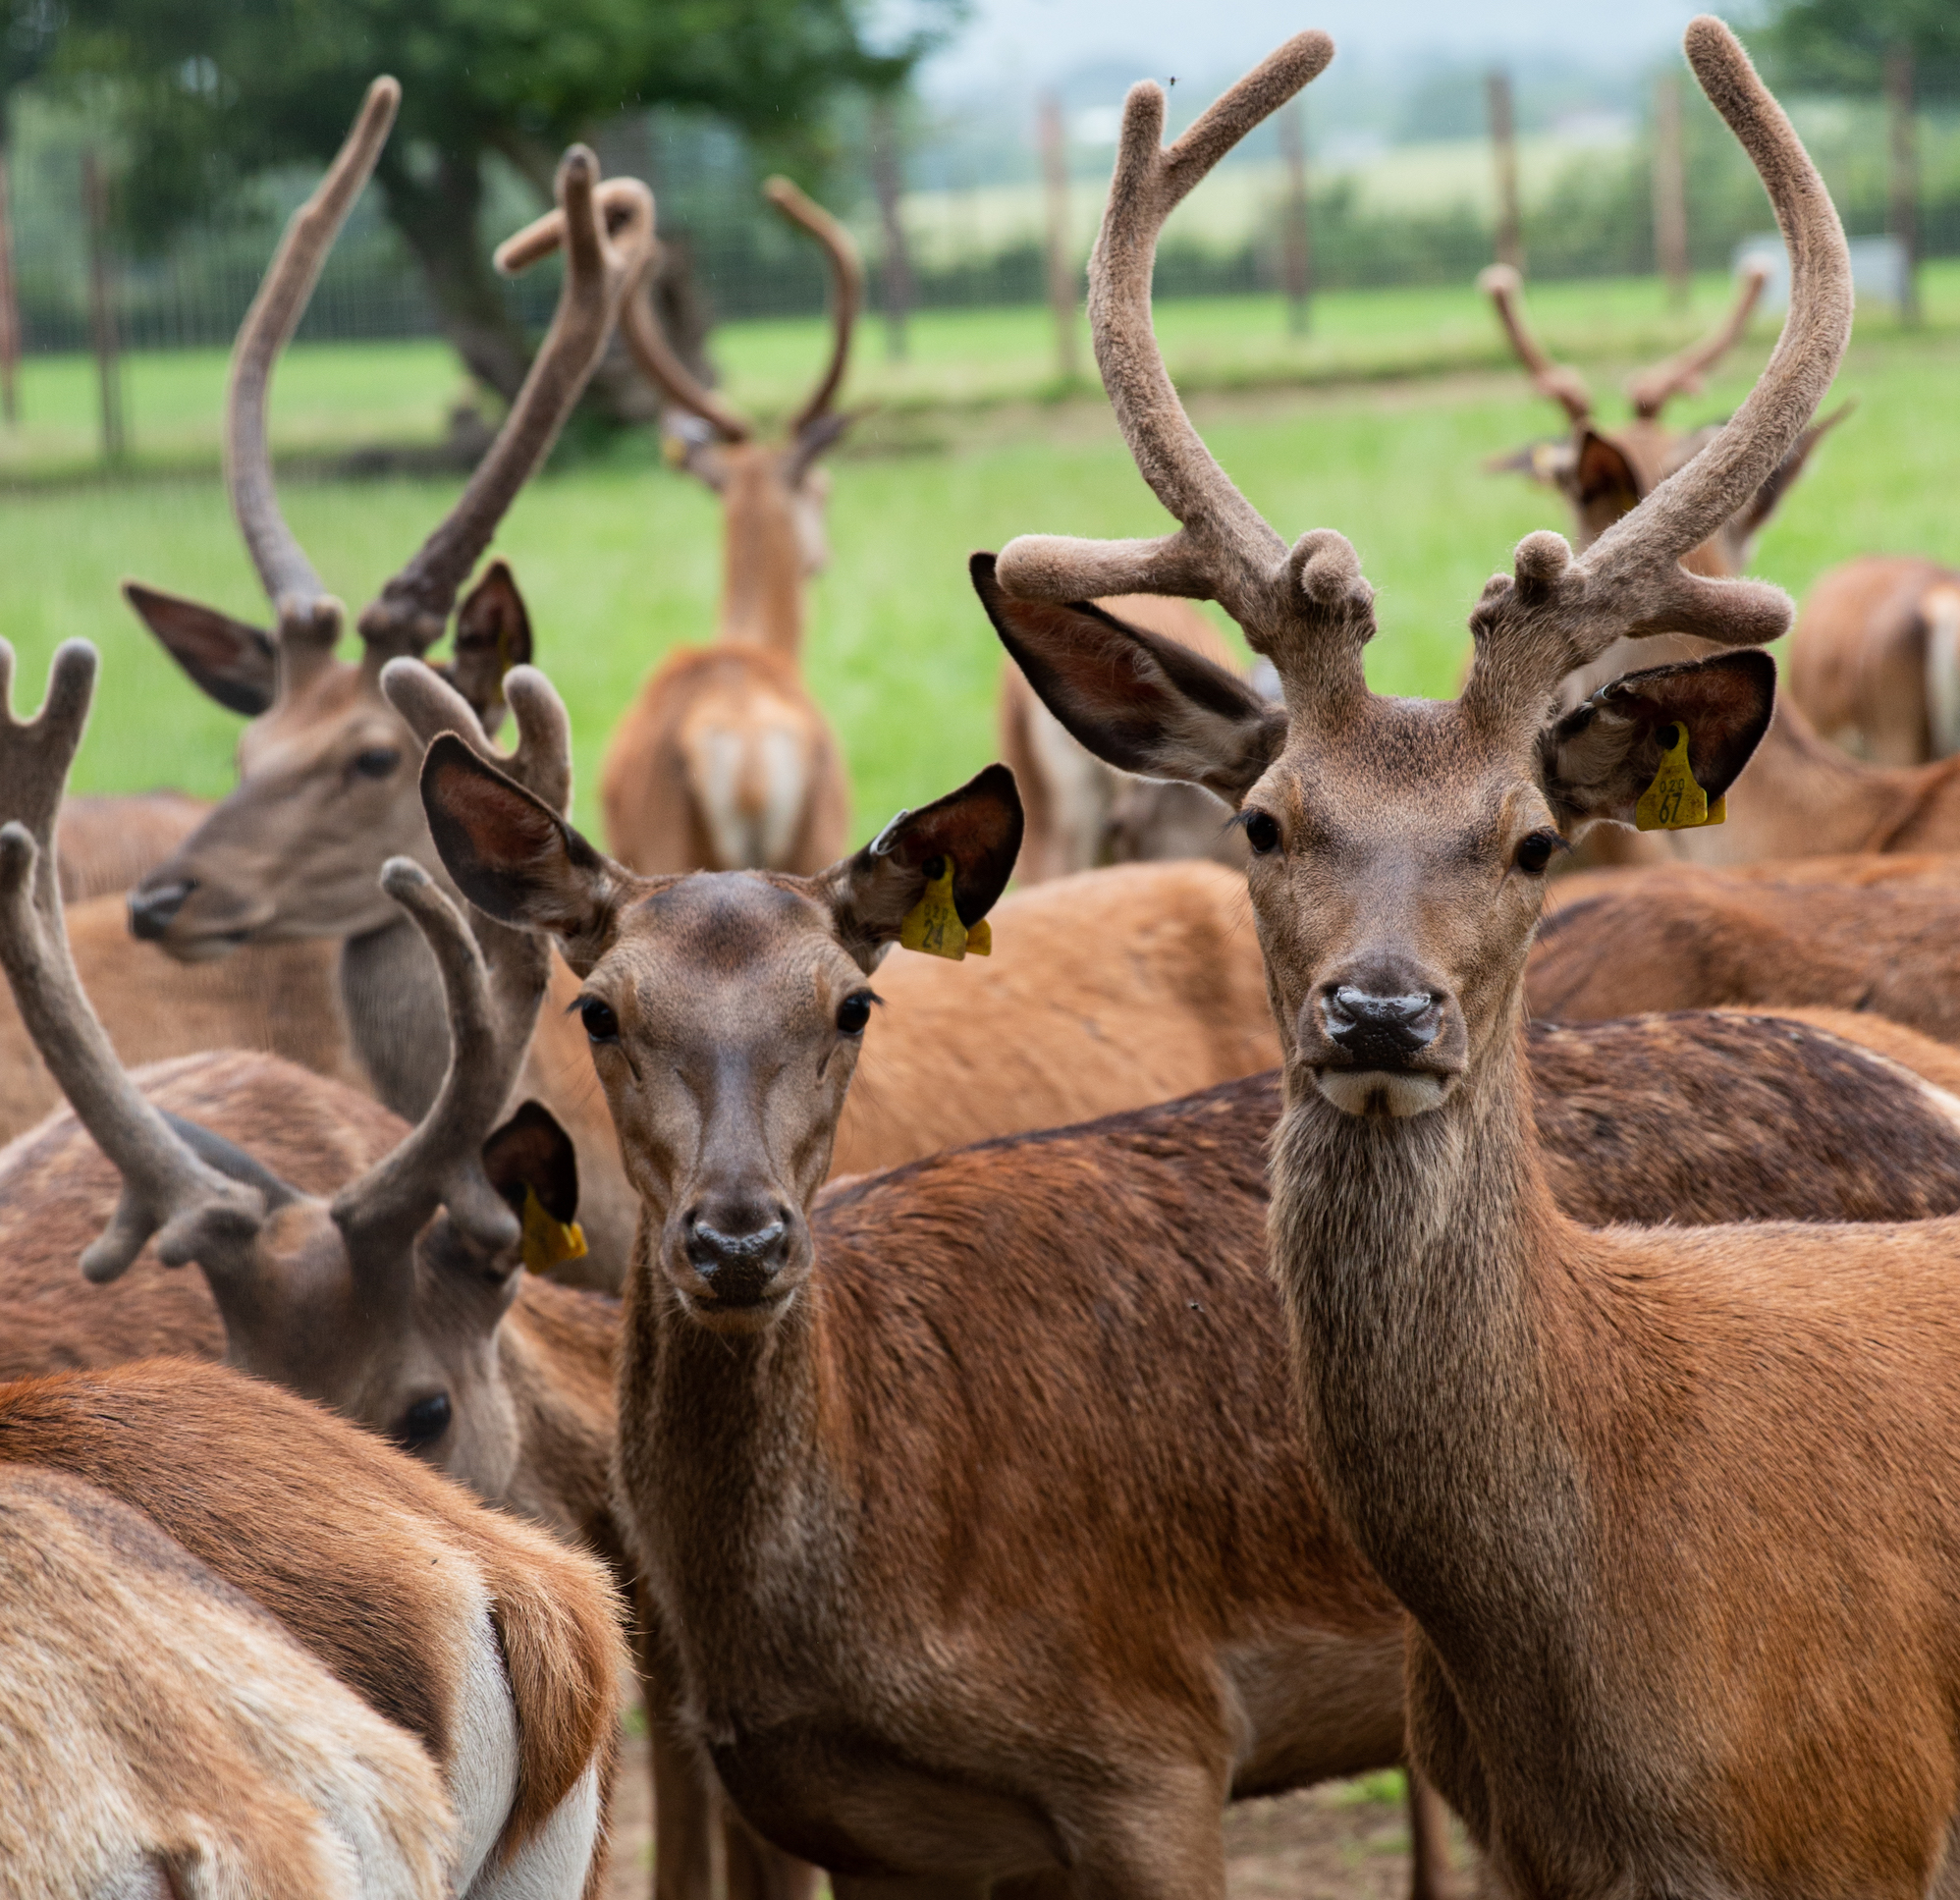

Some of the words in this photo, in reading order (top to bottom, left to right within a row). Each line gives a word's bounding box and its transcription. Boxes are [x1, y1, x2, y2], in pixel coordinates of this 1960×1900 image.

[1660, 779, 1685, 793] 020
[1660, 793, 1682, 824] 67
[922, 919, 945, 950] 24
